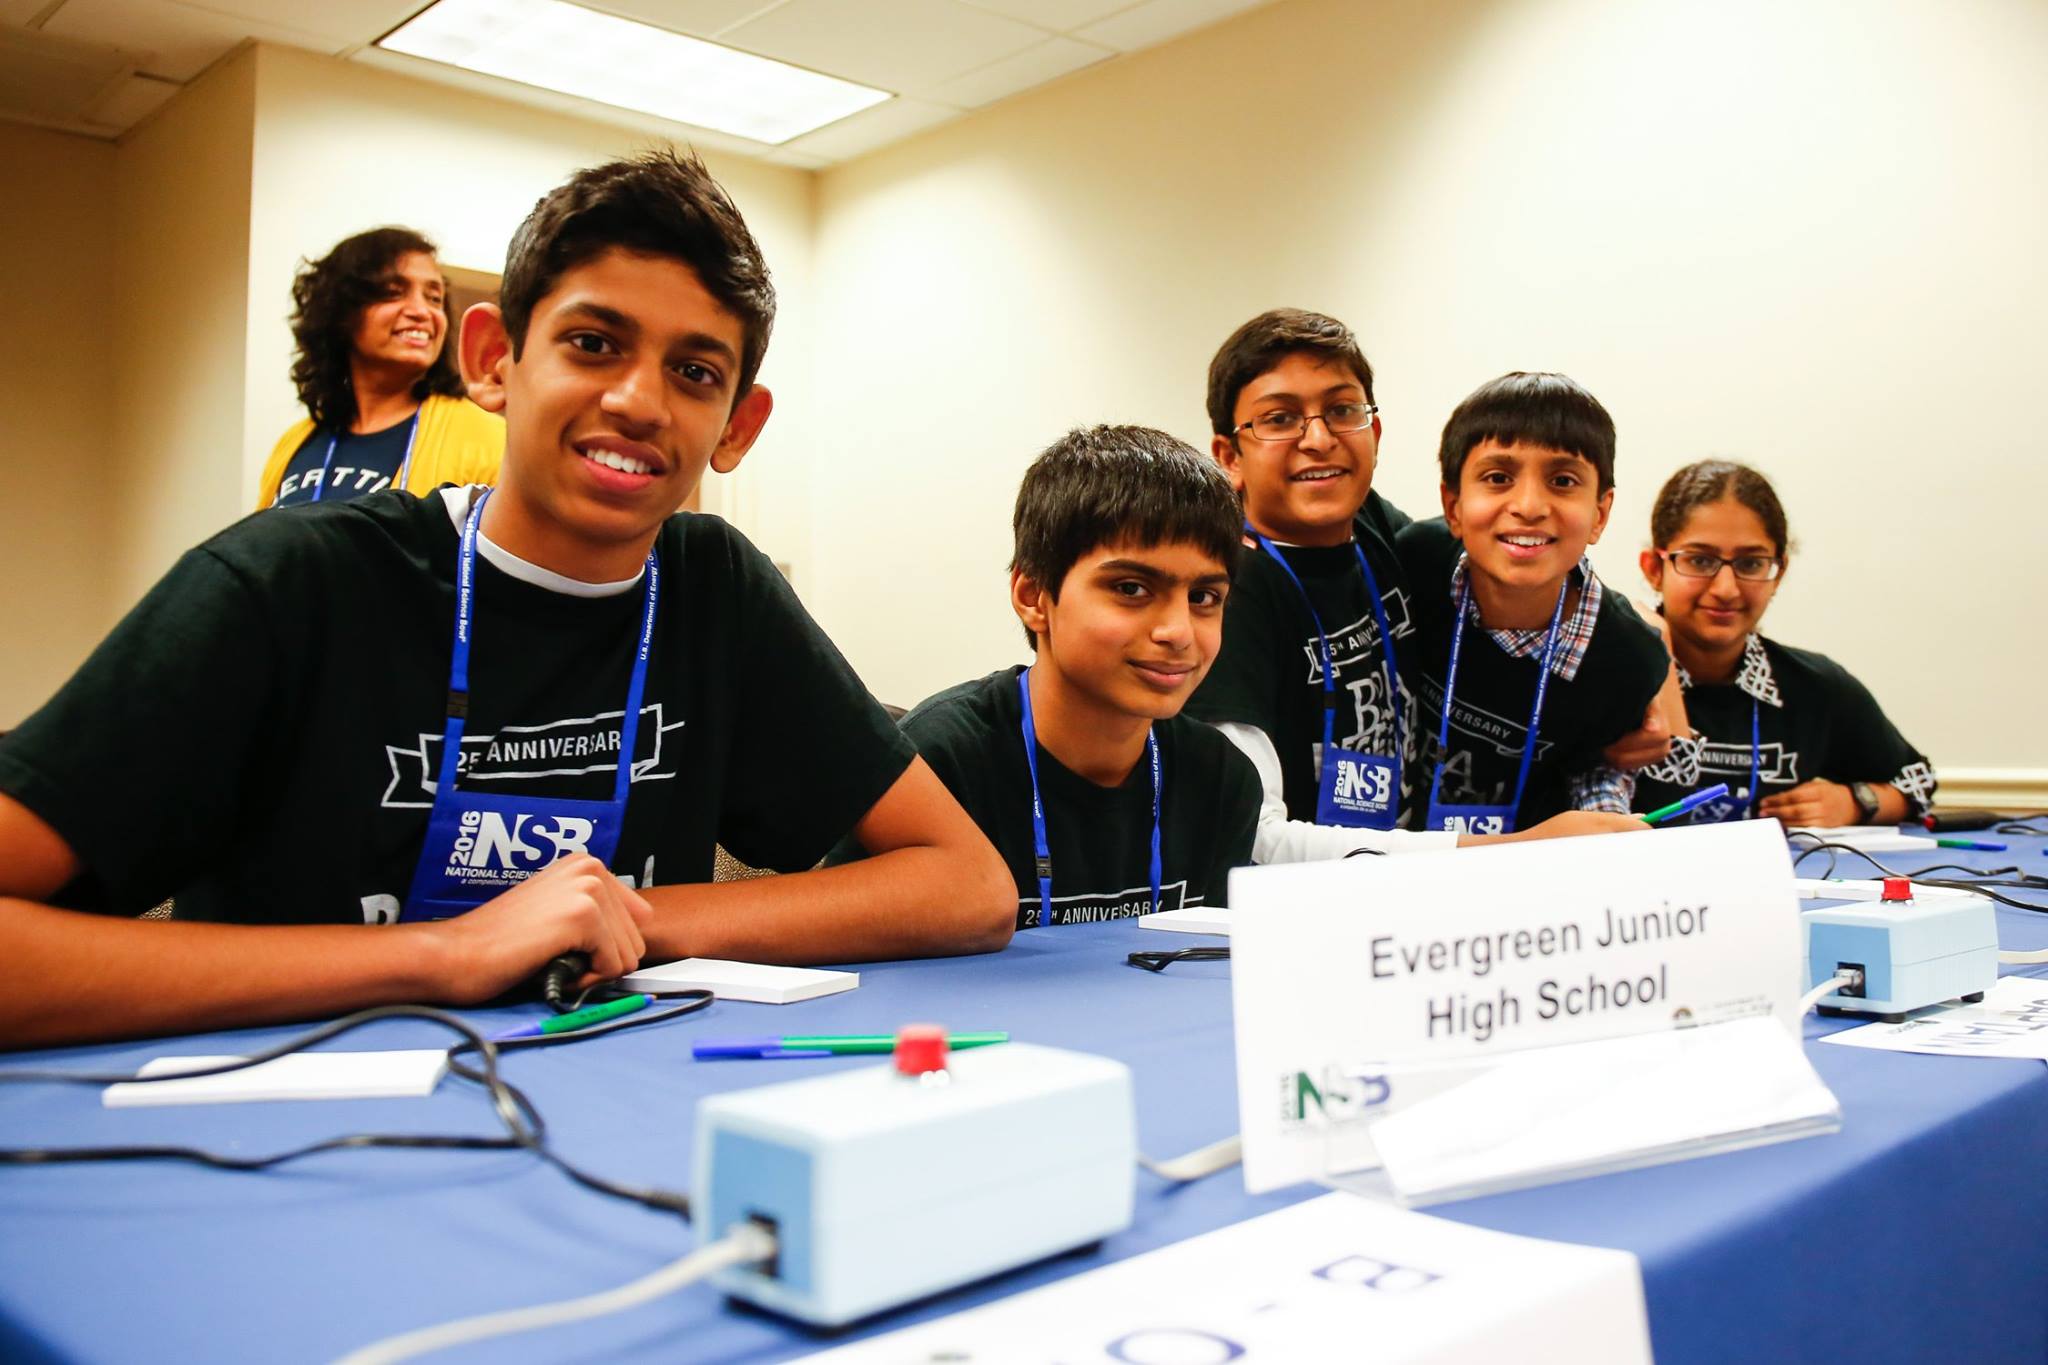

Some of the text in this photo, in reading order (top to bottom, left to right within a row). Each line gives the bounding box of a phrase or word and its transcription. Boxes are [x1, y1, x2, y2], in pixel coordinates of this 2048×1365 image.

[460, 588, 470, 618] Science
[643, 602, 655, 644] Department
[650, 567, 658, 592] Energy
[1422, 683, 1512, 740] ANNVERSARY
[486, 730, 621, 762] ANNIVERSAR
[1334, 760, 1347, 797] 2016
[1343, 761, 1391, 803] NSB
[449, 811, 593, 870] 2016 NSB
[445, 866, 540, 880] NATIONAL SCIEN
[1062, 900, 1163, 924] ANNIVESARY
[1371, 902, 1710, 979] Evergreen Junior
[1428, 988, 1520, 1042] High
[1537, 963, 1668, 1021] School
